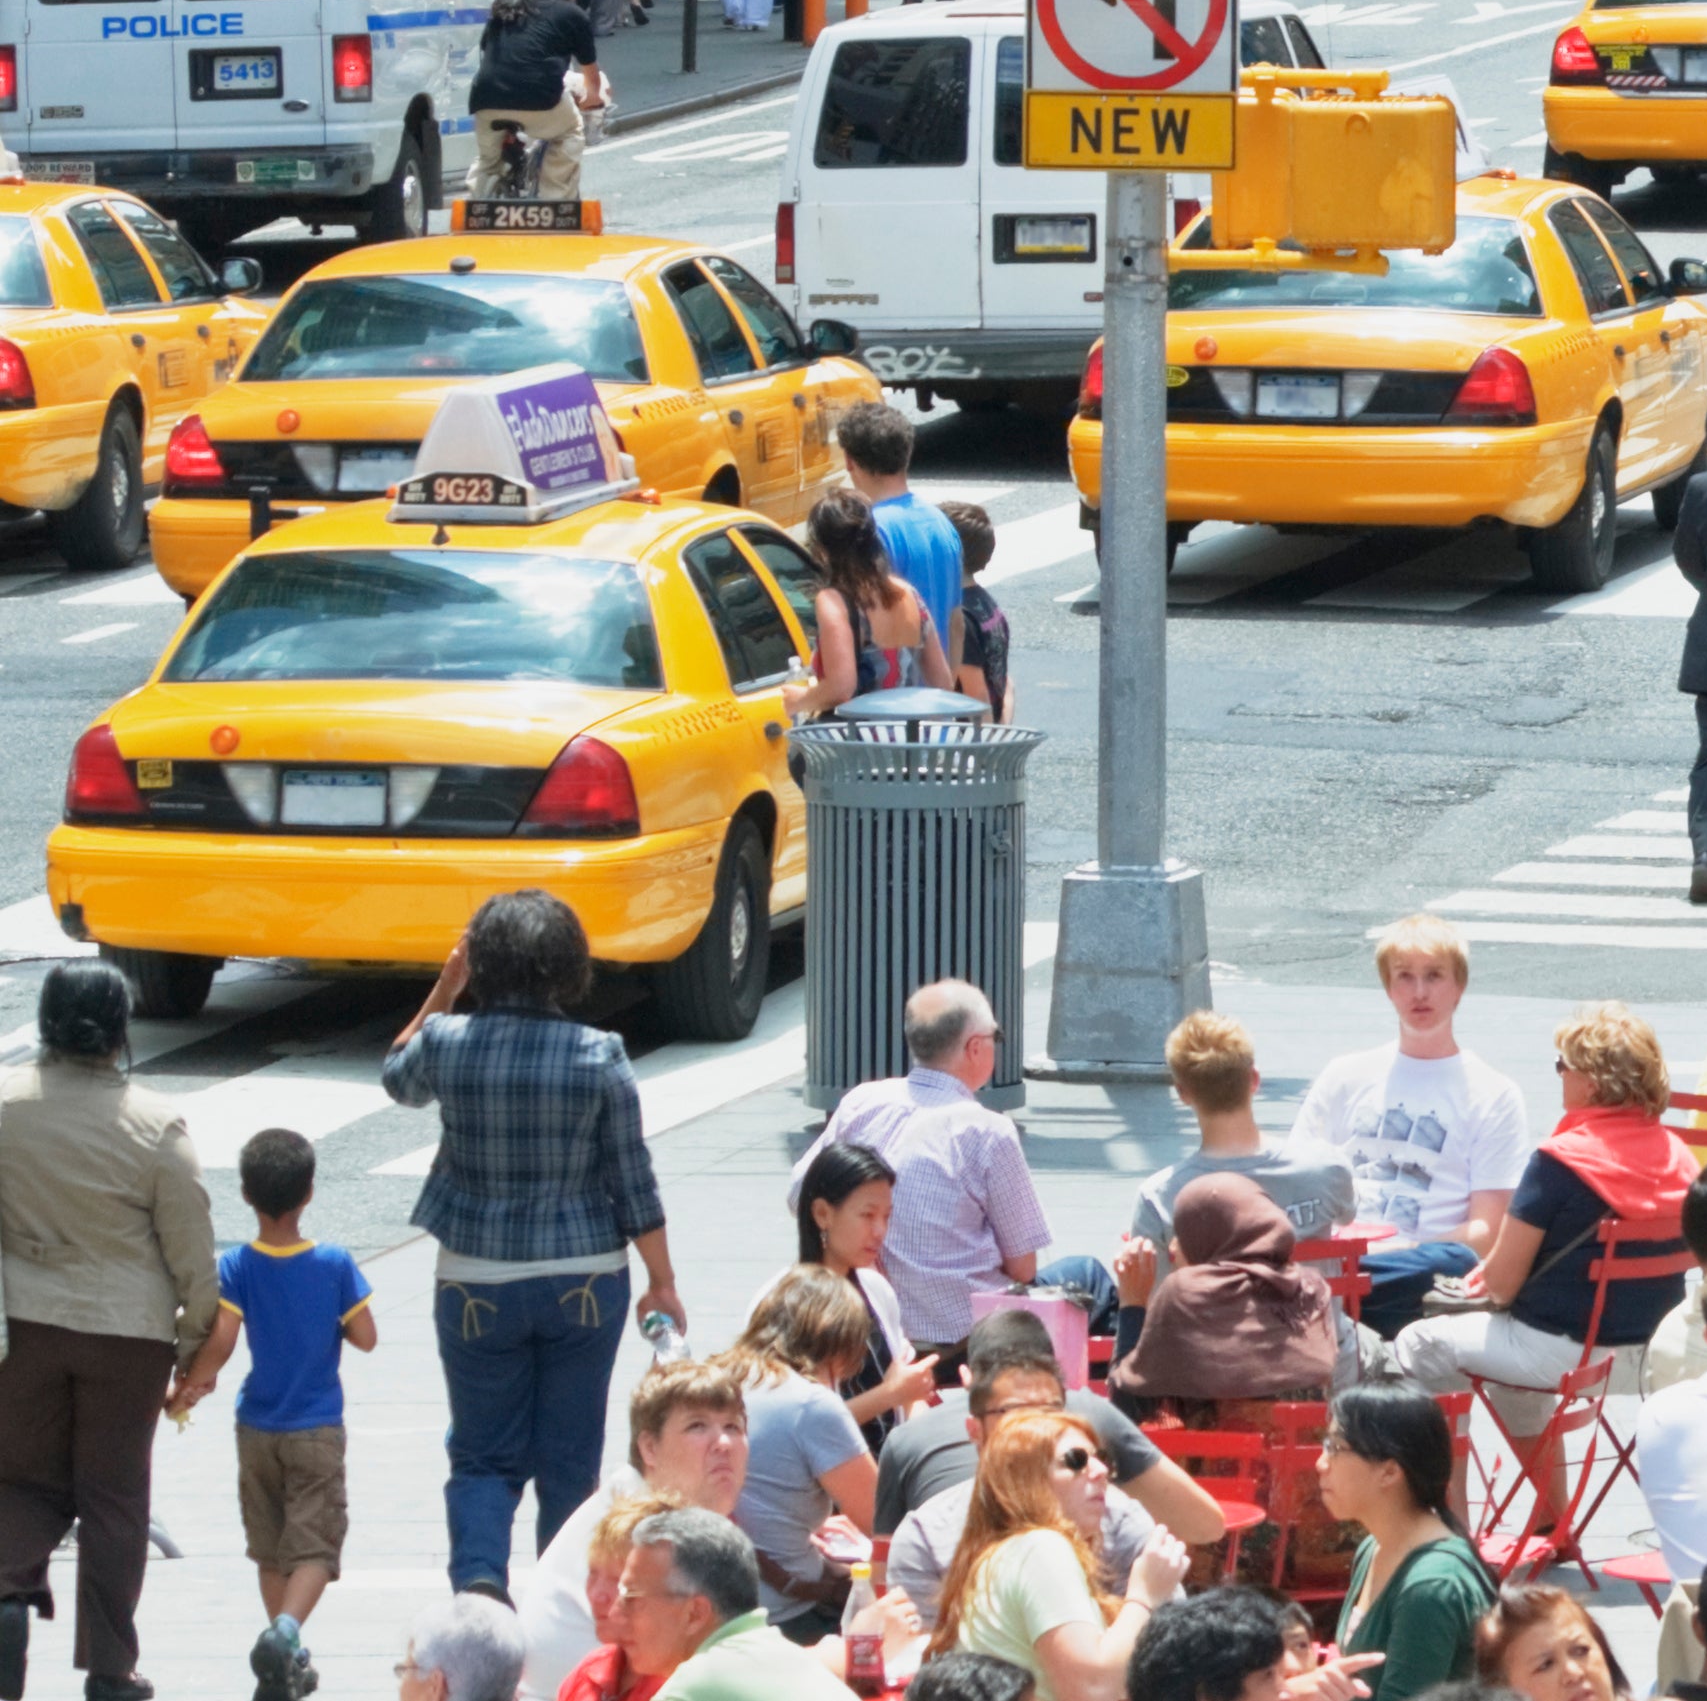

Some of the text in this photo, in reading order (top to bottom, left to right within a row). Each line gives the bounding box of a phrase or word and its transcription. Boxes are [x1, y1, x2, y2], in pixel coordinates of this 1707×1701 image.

[102, 13, 244, 39] POLICE
[219, 61, 275, 82] 5413
[1070, 107, 1190, 155] NEW
[494, 204, 555, 230] 2K59
[433, 478, 495, 504] 9G23
